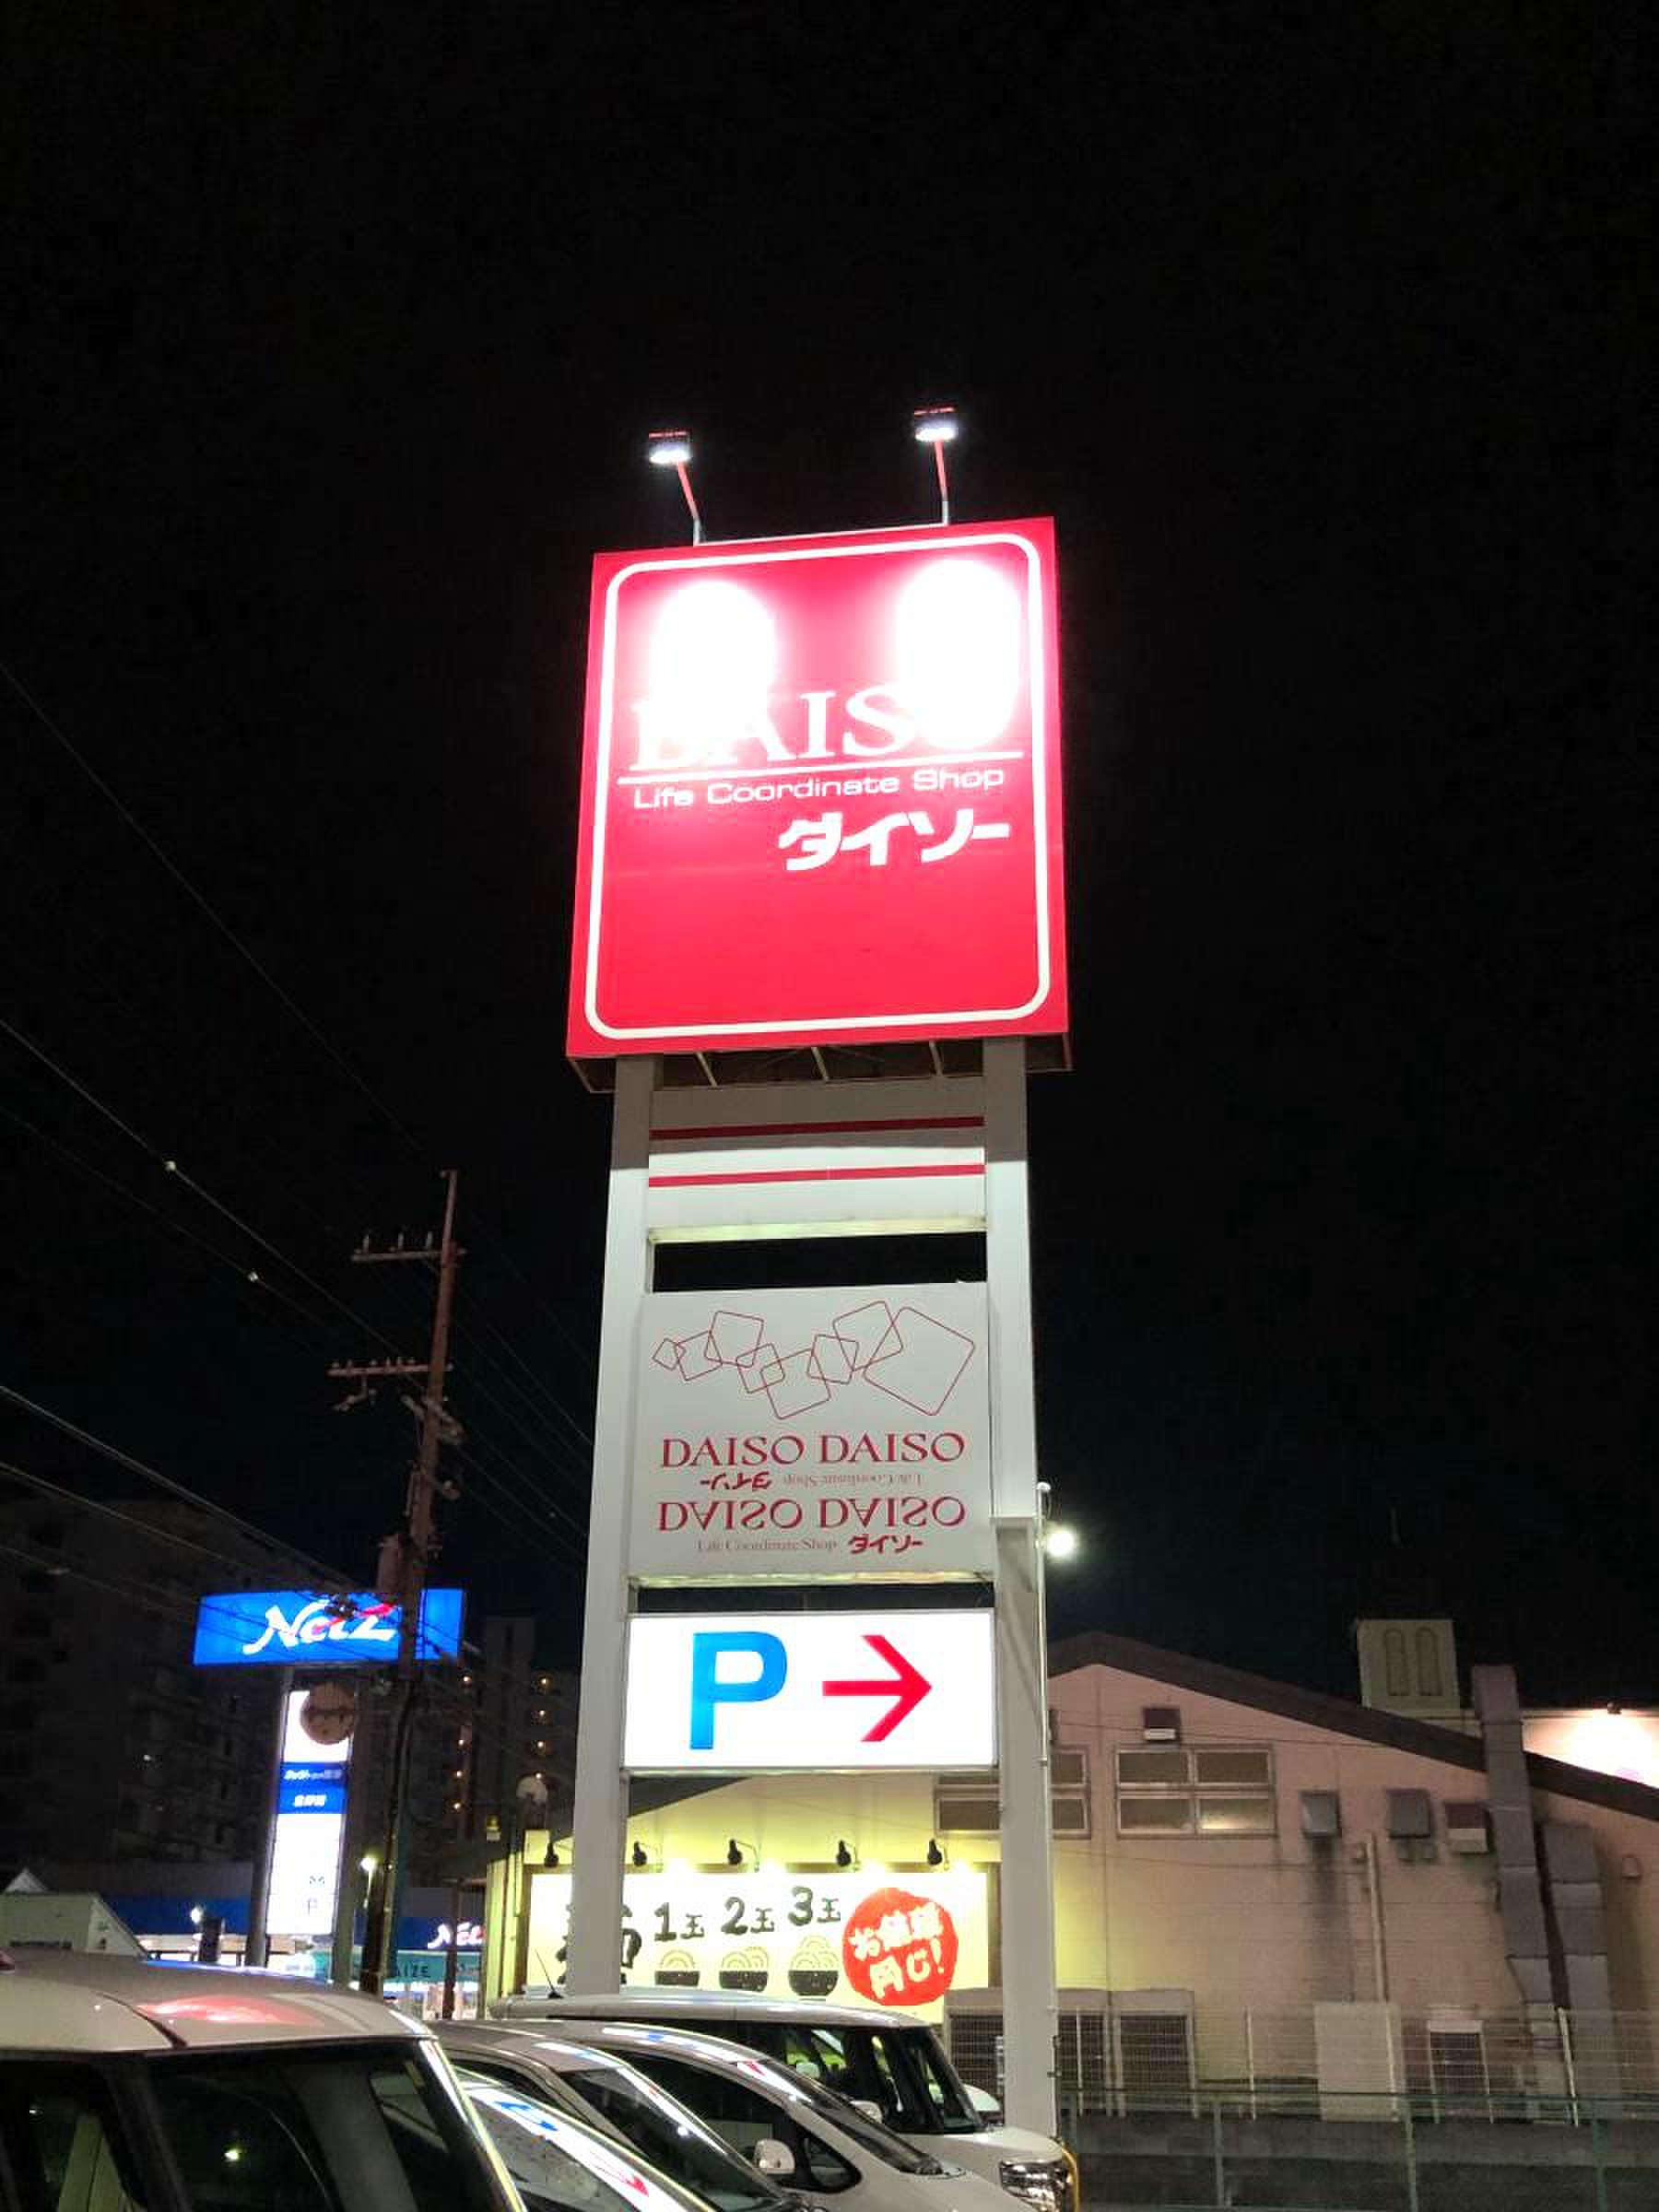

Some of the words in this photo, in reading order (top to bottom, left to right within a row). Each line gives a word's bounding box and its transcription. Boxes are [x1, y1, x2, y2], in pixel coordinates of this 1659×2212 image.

[633, 785, 694, 809] Life
[707, 775, 900, 806] Coordinate
[912, 767, 1005, 792] Shop
[778, 807, 1011, 871] ダイソー
[660, 1435, 805, 1468] DAISO
[819, 1431, 965, 1464] DAISO
[847, 1534, 924, 1555] ダイソー
[689, 1630, 788, 1751] P
